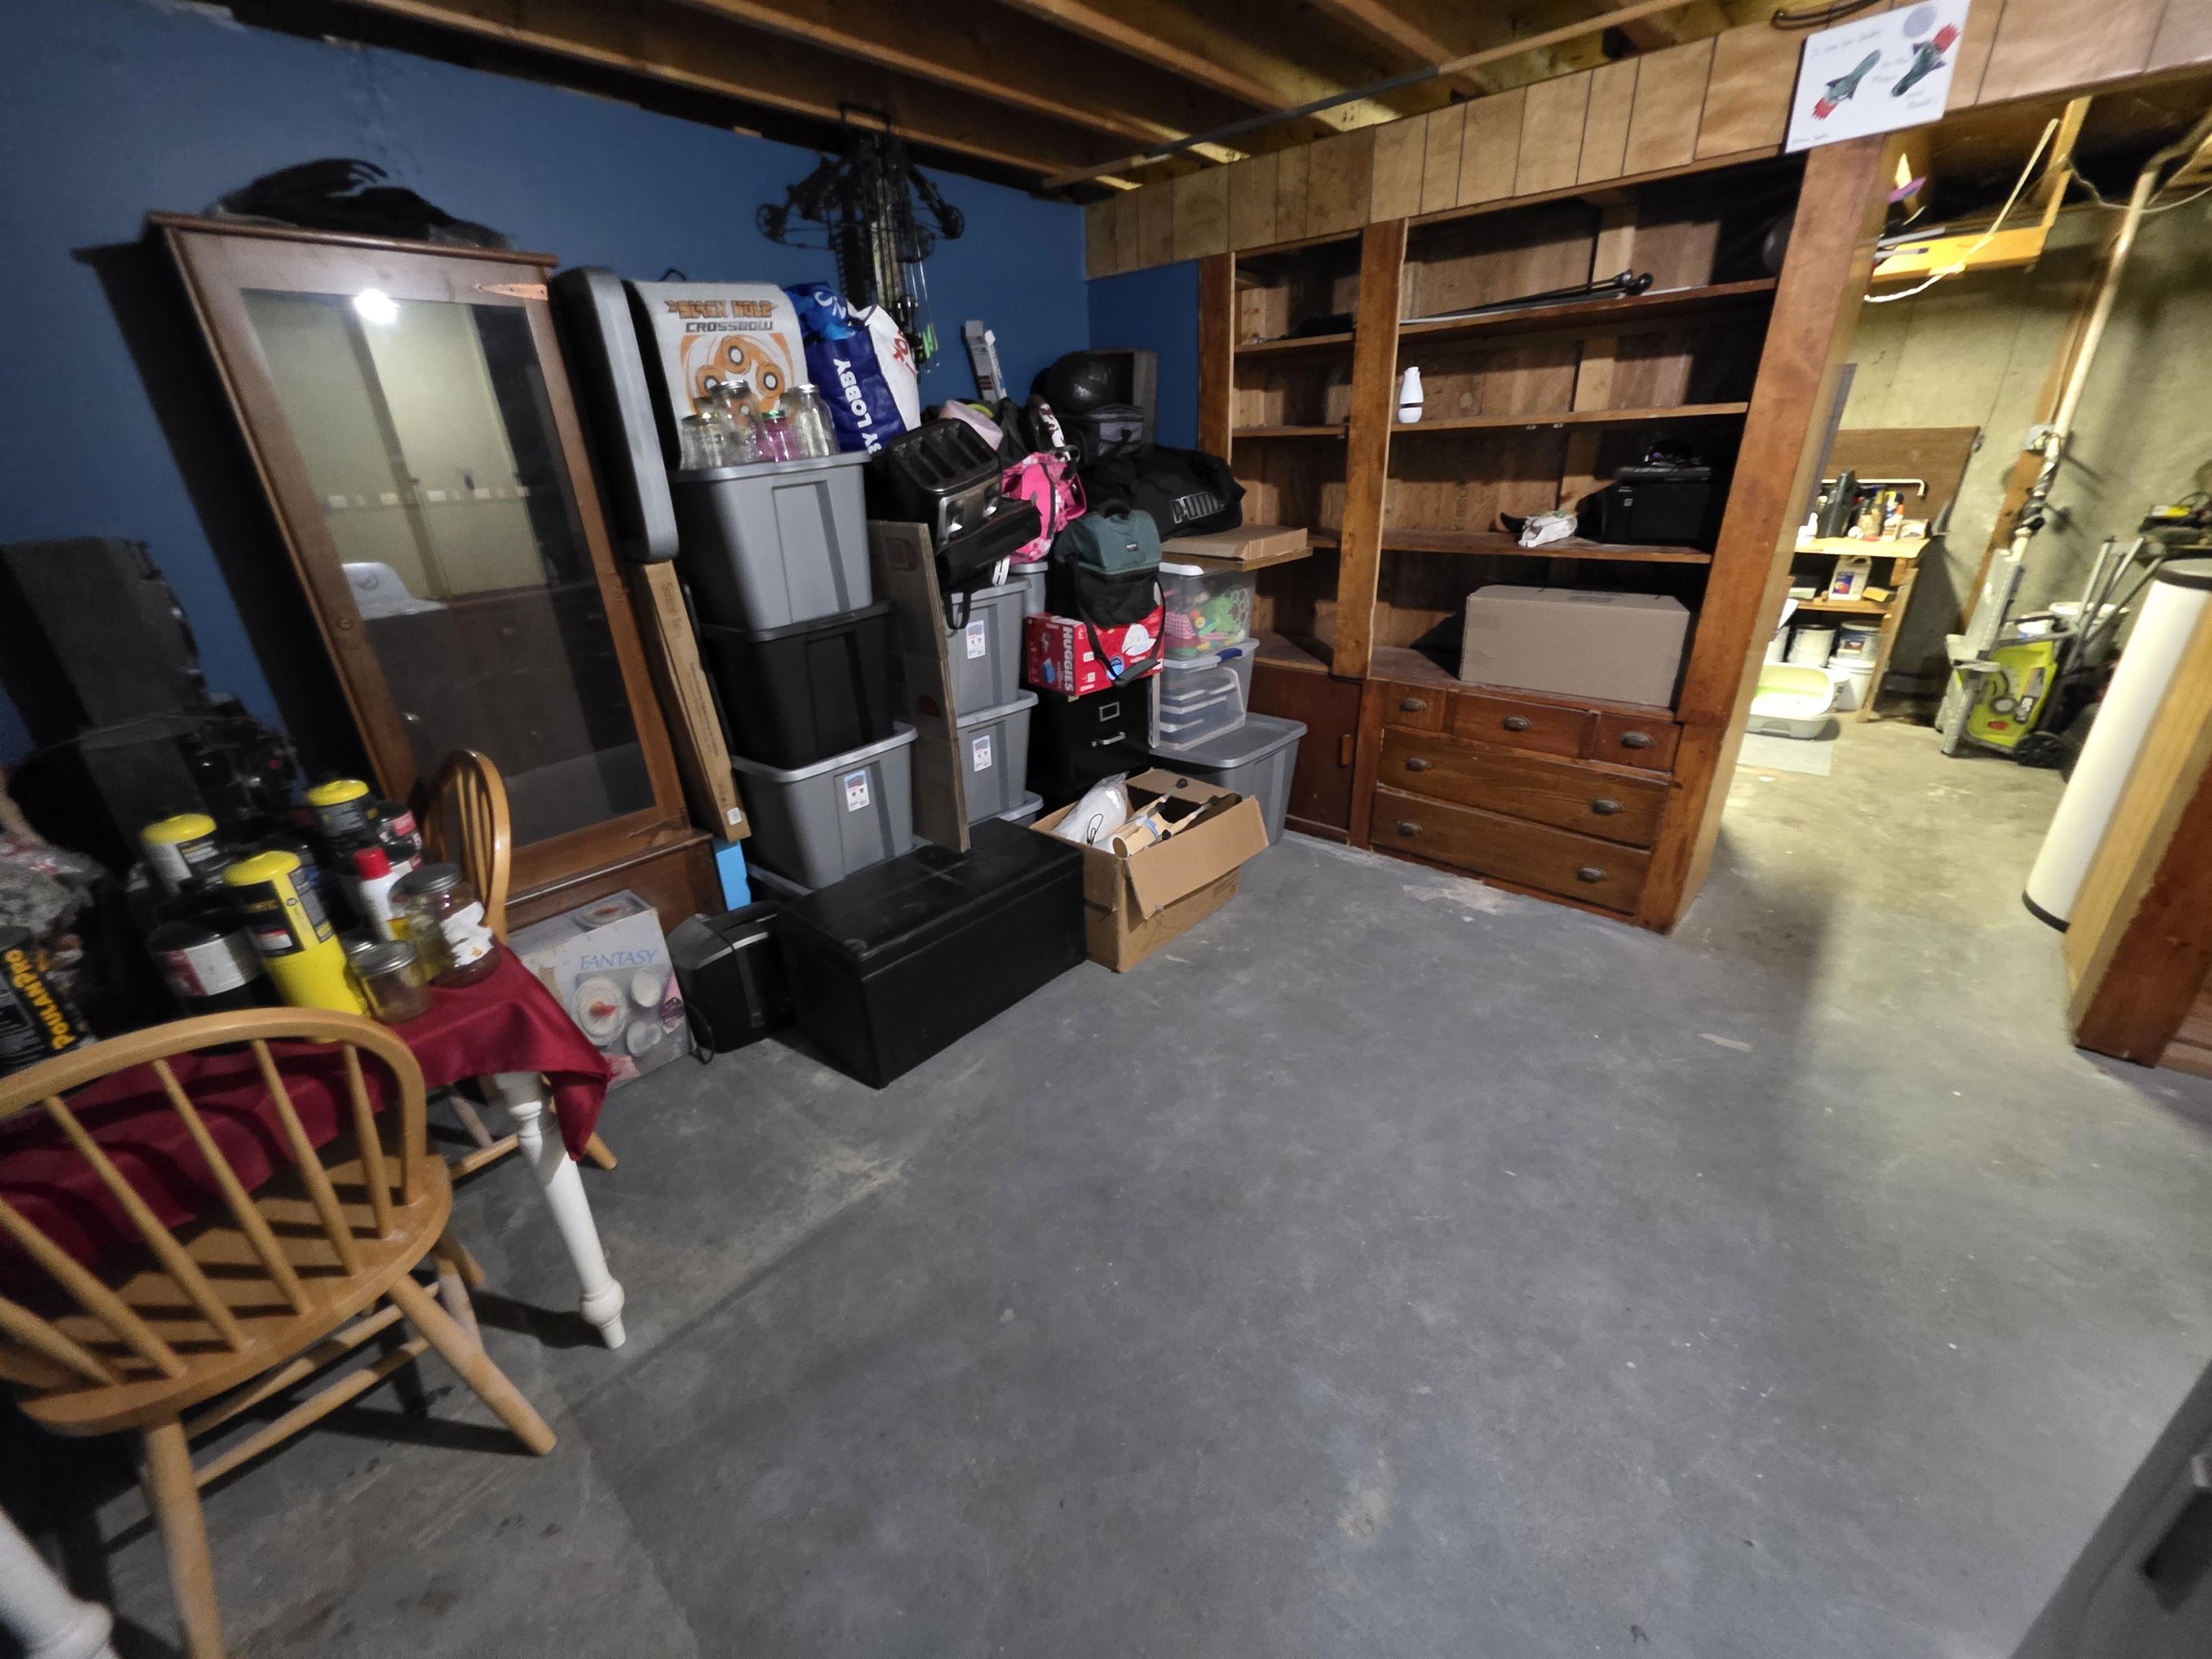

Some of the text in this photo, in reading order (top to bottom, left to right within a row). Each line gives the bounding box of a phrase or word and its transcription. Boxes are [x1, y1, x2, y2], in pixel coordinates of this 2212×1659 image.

[731, 300, 773, 319] HOLE
[685, 320, 773, 333] CROSSBOW
[833, 358, 872, 428] LOBBY
[1063, 626, 1074, 693] HUGGIES
[580, 949, 658, 971] FANTASY
